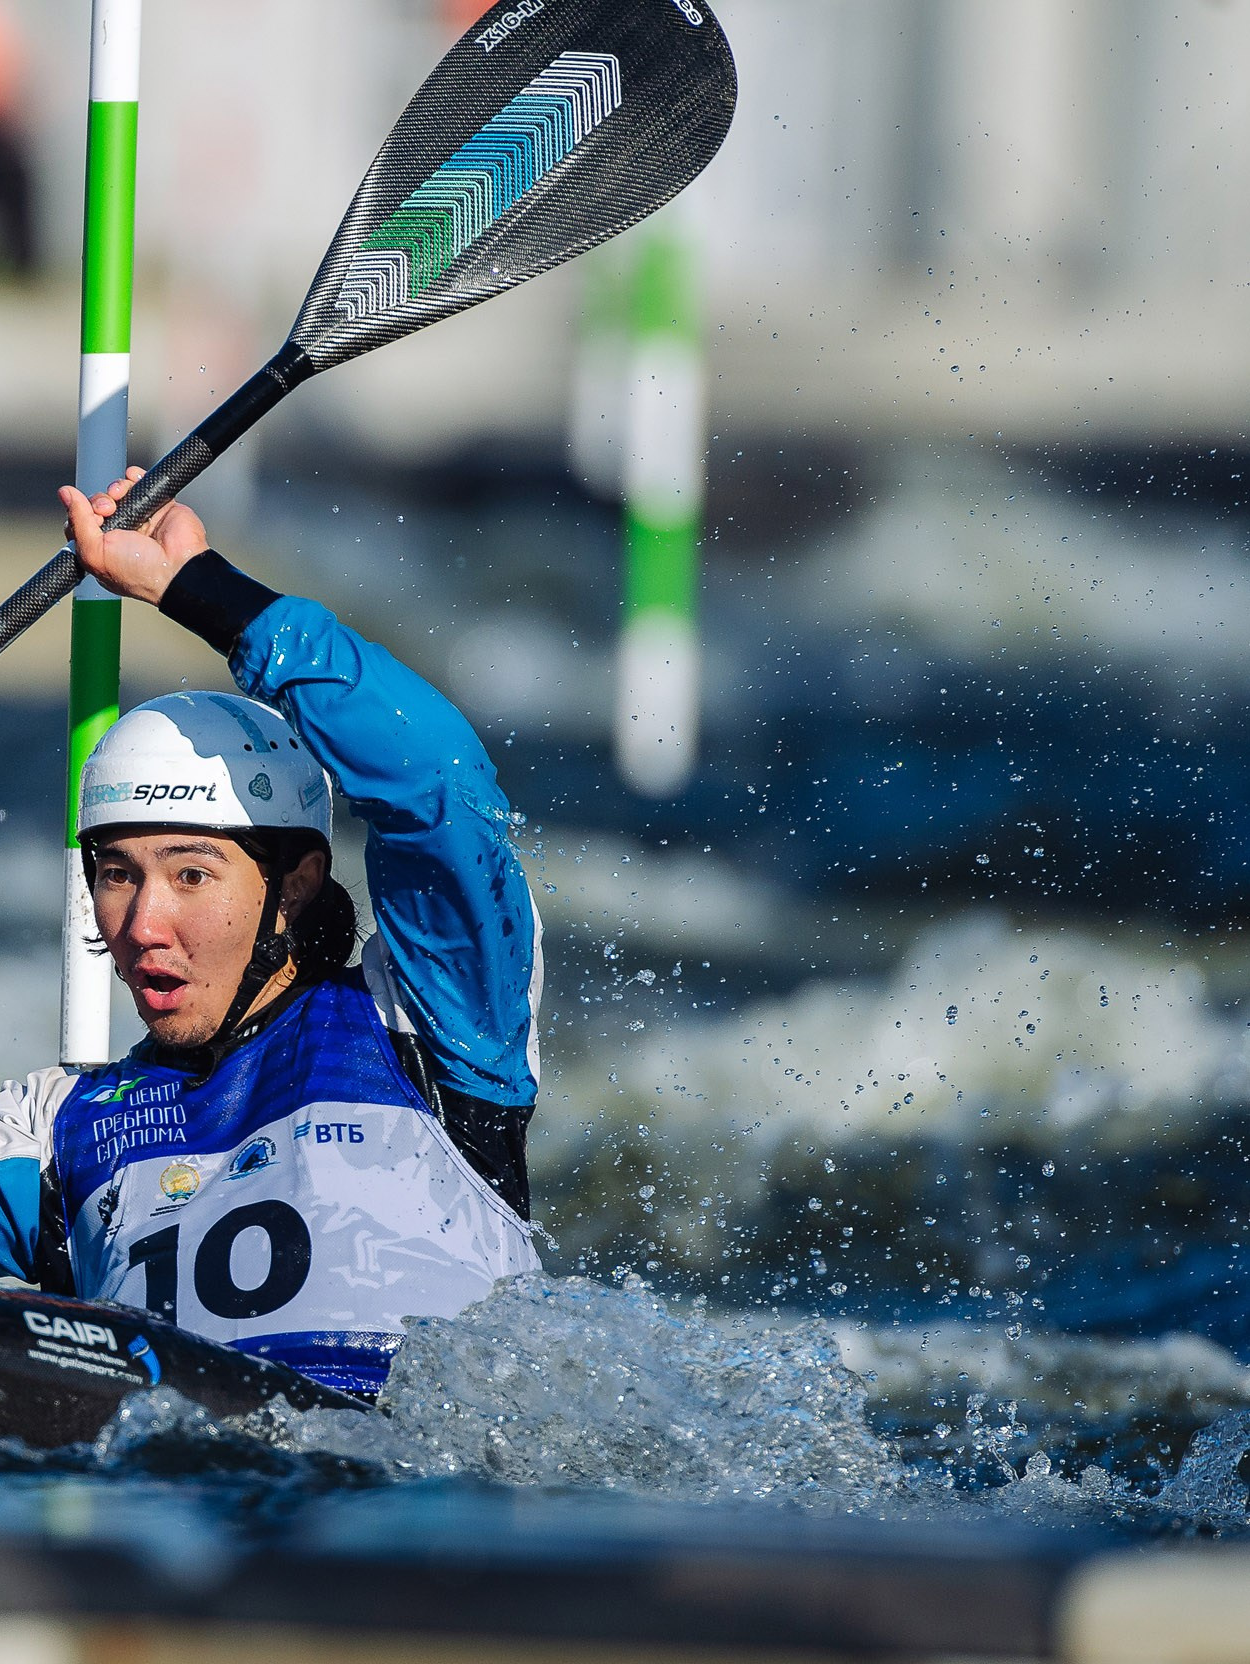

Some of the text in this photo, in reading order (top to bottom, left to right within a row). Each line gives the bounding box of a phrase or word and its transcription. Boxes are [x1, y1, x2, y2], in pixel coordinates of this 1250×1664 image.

[129, 1081, 180, 1106] ЦЕНТР
[93, 1104, 186, 1141] ГРЕБНОГО
[315, 1123, 365, 1143] ВТБ
[96, 1127, 187, 1164] СЛАЛОМА
[128, 1199, 312, 1328] 10
[22, 1310, 118, 1351] CAIPI
